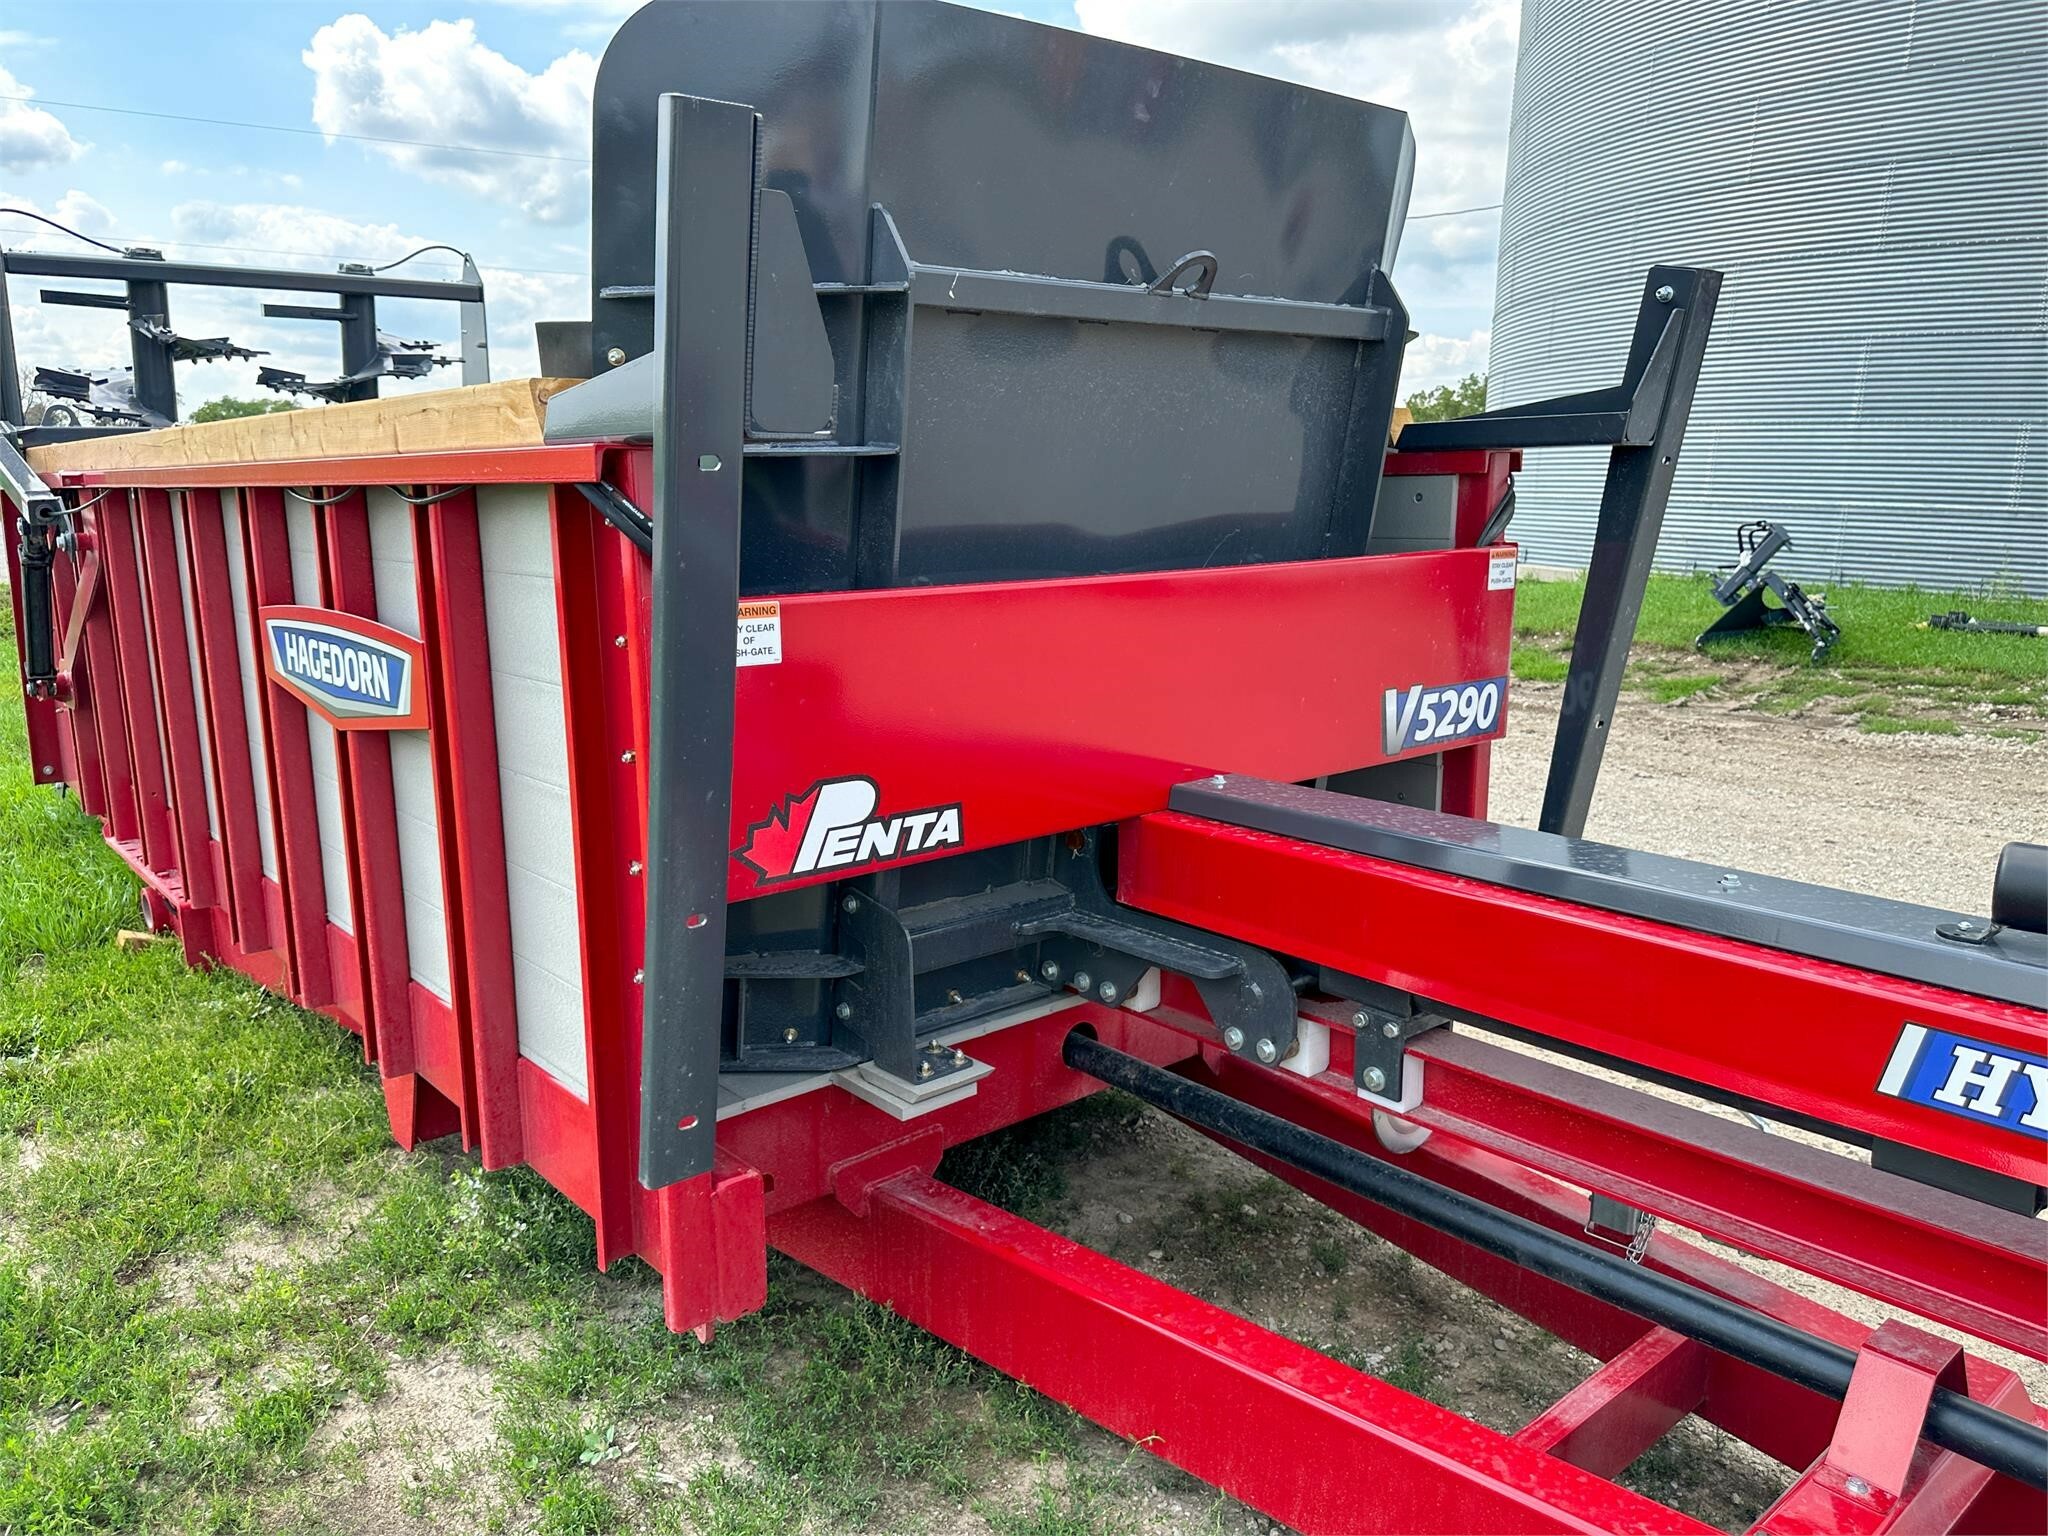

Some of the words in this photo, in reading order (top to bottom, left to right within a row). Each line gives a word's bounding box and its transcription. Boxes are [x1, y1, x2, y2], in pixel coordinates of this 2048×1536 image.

[737, 605, 777, 617] ARNING
[745, 623, 775, 633] CLEAR
[743, 636, 756, 645] OF
[736, 646, 776, 657] SH-GATE.
[284, 632, 391, 702] HAGEDORN
[1384, 682, 1499, 755] V5290
[792, 779, 960, 874] PENTA
